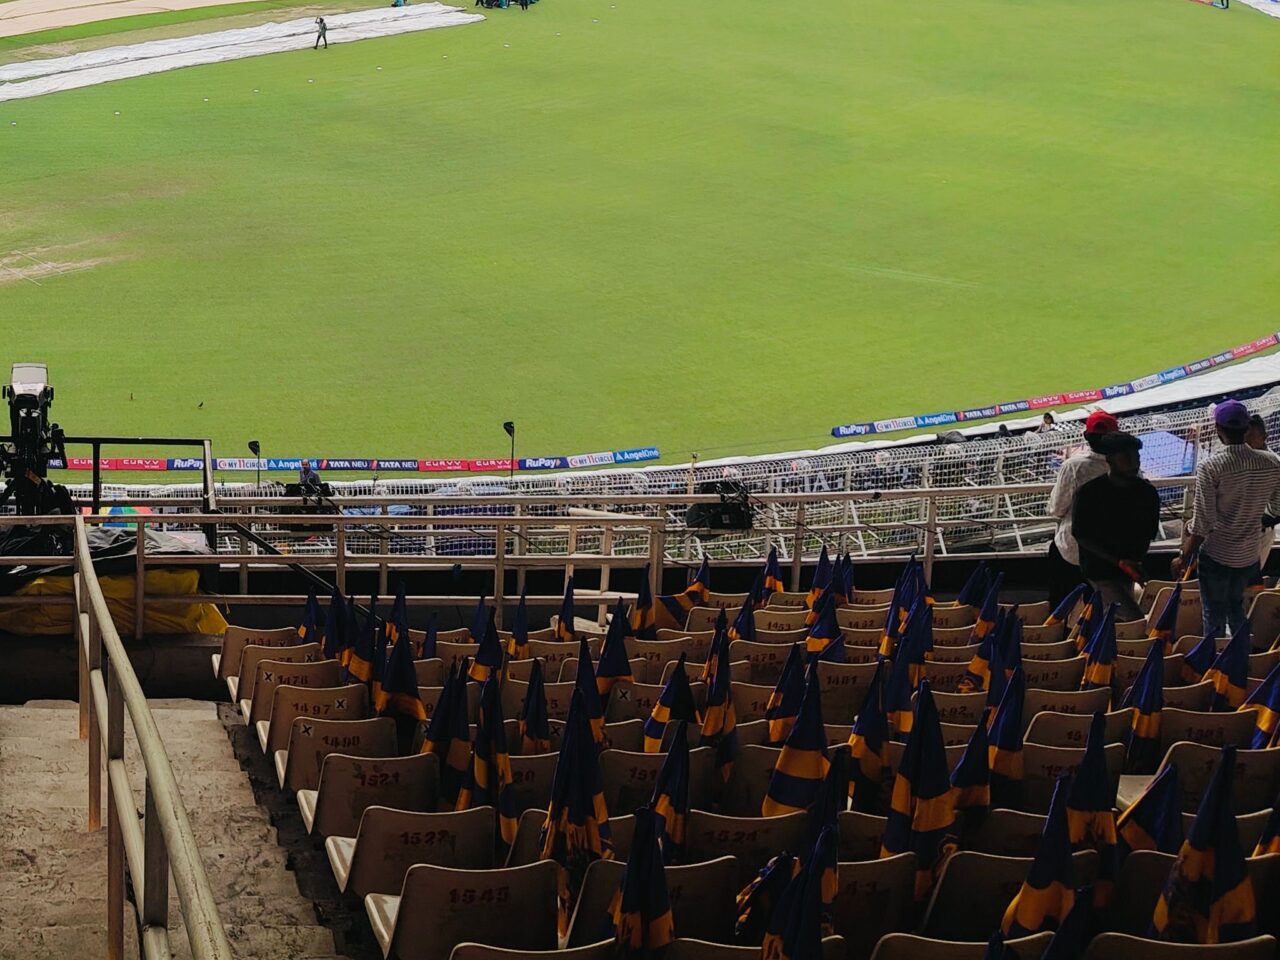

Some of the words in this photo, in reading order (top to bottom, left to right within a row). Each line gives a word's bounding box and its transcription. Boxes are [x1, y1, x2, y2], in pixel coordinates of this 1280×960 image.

[1000, 404, 1017, 412] TATA
[965, 410, 982, 418] TATA
[924, 414, 955, 425] AngelOne
[839, 425, 865, 435] RuPay
[623, 449, 659, 460] AngelOne
[174, 459, 204, 469] RuPay
[379, 461, 400, 469] TATA
[401, 461, 418, 469] NEU
[525, 458, 557, 469] RuPay
